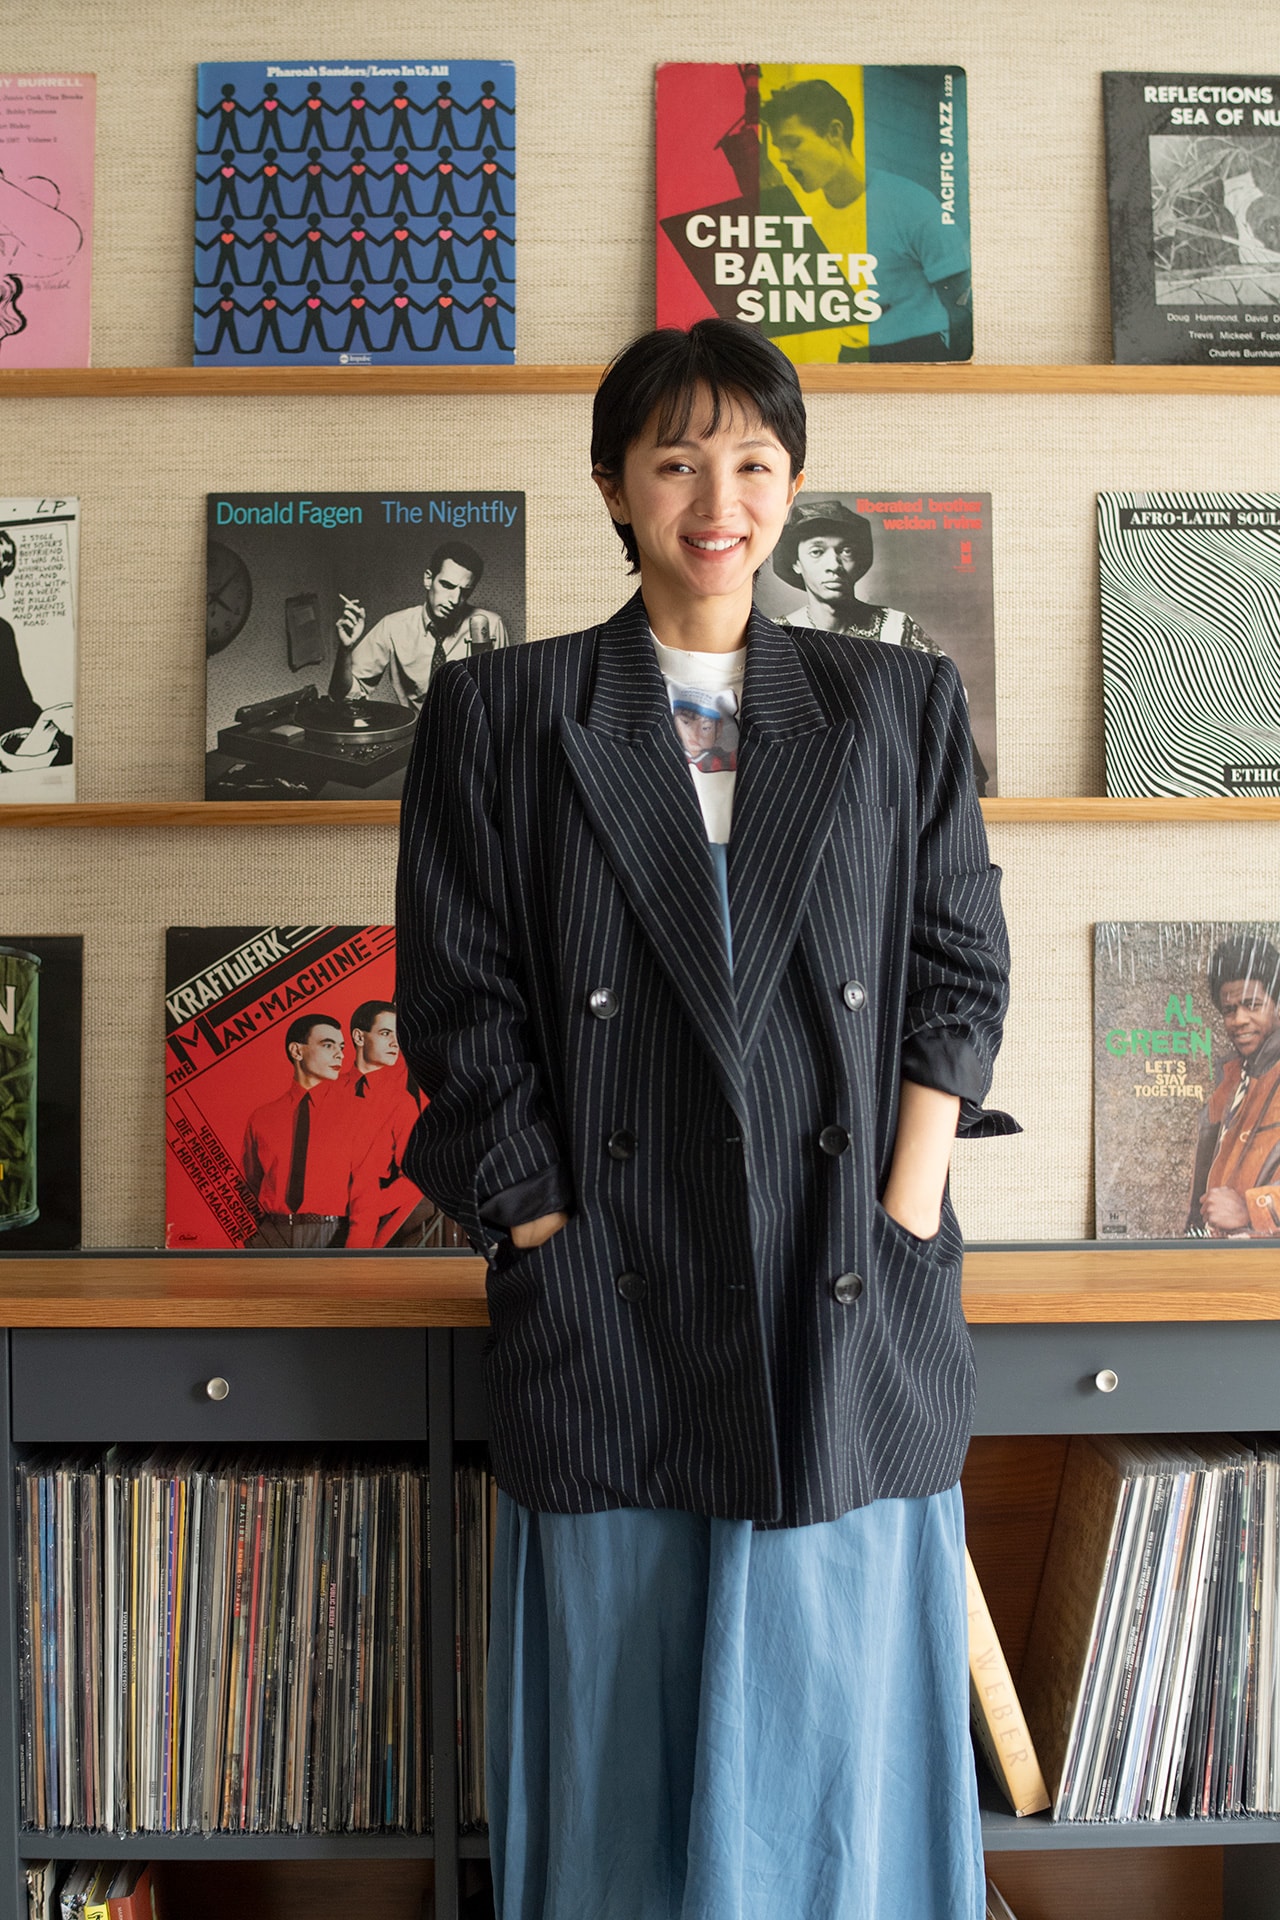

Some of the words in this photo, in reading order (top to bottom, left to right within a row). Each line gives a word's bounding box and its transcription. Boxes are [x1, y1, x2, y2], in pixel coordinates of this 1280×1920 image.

[266, 66, 317, 78] Pharoah
[430, 65, 449, 77] All
[17, 77, 83, 88] BURRELL
[1144, 86, 1274, 104] REFLECTIONS
[939, 101, 954, 147] JAZZ
[1170, 107, 1210, 125] SEA
[1215, 108, 1244, 126] OF
[940, 151, 955, 225] PACIFIC
[685, 214, 813, 249] CHET
[714, 252, 879, 286] BAKER
[735, 289, 883, 323] SINGS
[1166, 313, 1190, 323] Doug
[216, 501, 294, 525] Donald
[298, 501, 363, 529] Fagen
[380, 501, 423, 524] The
[428, 500, 518, 528] Nightfly
[855, 497, 923, 513] liberated
[927, 497, 983, 513] brother
[882, 515, 937, 530] weldon
[943, 515, 983, 530] irvine
[1130, 511, 1231, 526] AFRO-LATIN
[1237, 511, 1280, 526] SOUL
[165, 929, 291, 1026] KRAFTWERK
[1164, 993, 1203, 1029] AL
[1105, 1027, 1213, 1068] GREEN
[166, 1061, 196, 1086] THE
[1144, 1060, 1187, 1074] LET'S
[1155, 1074, 1188, 1086] STAY
[1133, 1084, 1204, 1102] TOGETHER
[175, 1118, 193, 1139] DIE
[975, 1647, 1029, 1767] WEBER
